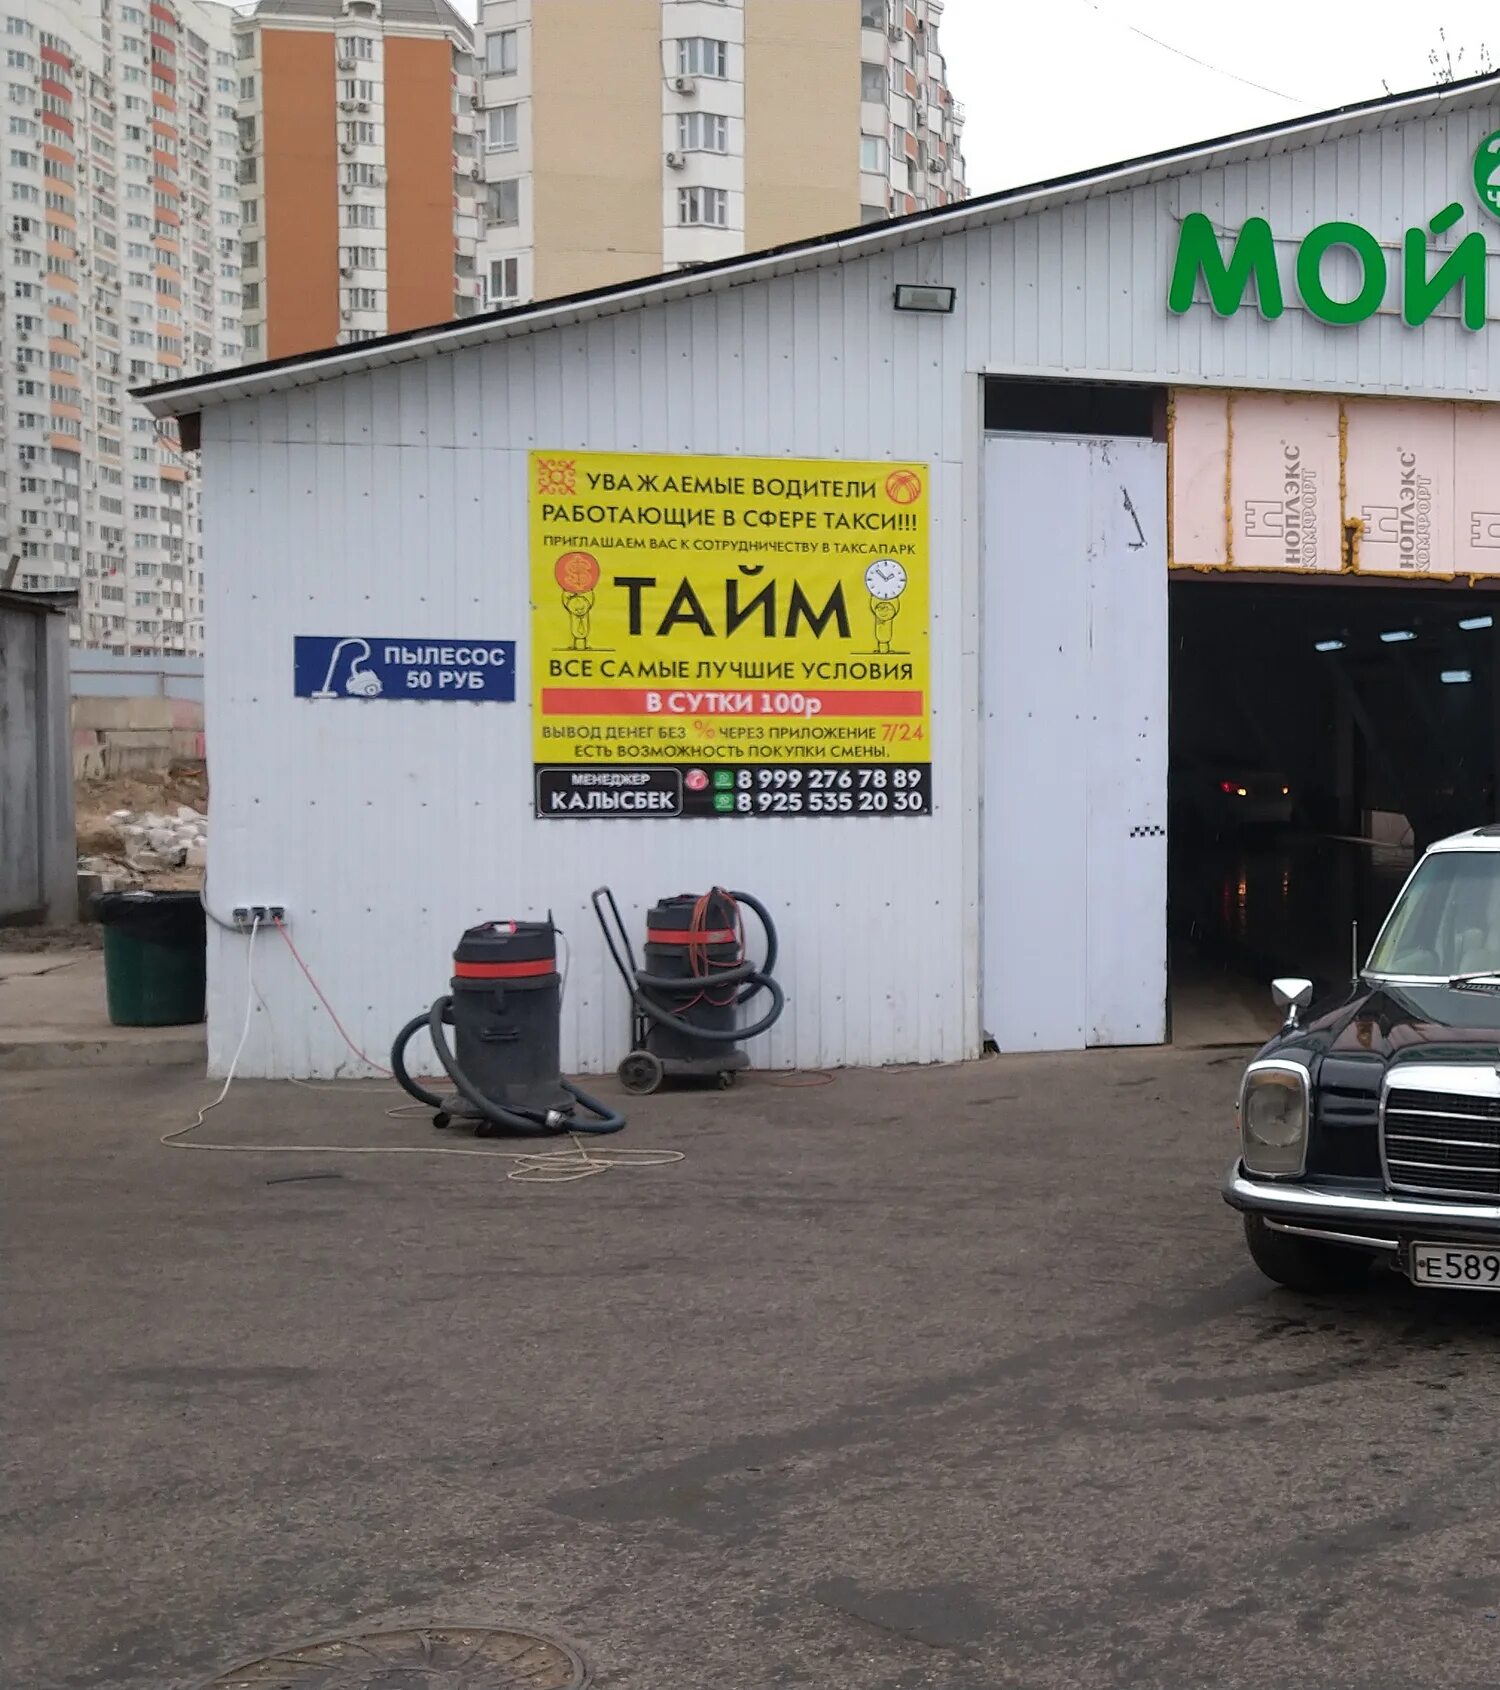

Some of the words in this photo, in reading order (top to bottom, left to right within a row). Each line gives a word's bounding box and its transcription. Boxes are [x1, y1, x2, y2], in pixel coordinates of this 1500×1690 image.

[1167, 202, 1487, 333] МОЙ
[586, 472, 745, 494] УВАЖАЕМЫЕ
[753, 478, 876, 499] ВОДИТЕЛИ
[1284, 445, 1300, 565] НОПЛЭКС
[1400, 452, 1415, 569] НОПЛЭКС
[542, 504, 716, 528] РАБОТАЮЩИЕ
[723, 509, 736, 526] В
[743, 510, 817, 528] СФЕРЕ
[824, 512, 917, 531] ТАКСИ!!!
[543, 535, 645, 549] ПРИГЛАШАЕМ
[650, 538, 677, 550] ВАС
[680, 539, 690, 550] К
[693, 540, 819, 553] СОТРУДНИЧЕСТВУ
[823, 542, 831, 553] В
[834, 543, 916, 555] ТАКСАПАРК
[614, 565, 852, 639] ТАЙМ
[384, 646, 506, 666] ПЫЛЕСОС
[406, 670, 432, 689] 50
[439, 671, 485, 690] РУБ
[549, 659, 593, 677] ВСЕ
[600, 660, 689, 679] САМЫЕ
[696, 662, 795, 680] ЛУЧШИЕ
[800, 662, 913, 681] УСЛОВИЯ
[646, 692, 662, 713] В
[668, 692, 753, 713] СУТКИ
[761, 692, 822, 720] 100р
[542, 726, 601, 740] ВЫВОД
[606, 726, 655, 740] ДЕНЕГ
[658, 726, 686, 740] БЕЗ
[694, 720, 716, 739] %
[719, 727, 765, 740] ЧЕРЕЗ
[769, 727, 876, 740] ПРИЛОЖЕНИЕ
[881, 723, 925, 743] 7/24
[575, 745, 613, 758] ЕСТЬ
[617, 745, 744, 758] ВОЗМОЖНОСТЬ
[749, 745, 826, 758] ПОКУПКИ
[830, 745, 890, 758] СМЕНЫ.
[571, 773, 651, 787] МЕНЕДЖЕР
[737, 769, 753, 789] 8
[758, 769, 803, 789] 999
[808, 769, 853, 789] 276
[858, 769, 888, 789] 78
[893, 769, 922, 789] 89
[551, 791, 675, 810] КАЛЫСБЕК
[737, 791, 752, 811] 8
[758, 791, 803, 812] 925
[808, 791, 853, 812] 535
[858, 791, 888, 812] 20
[893, 791, 923, 812] 30
